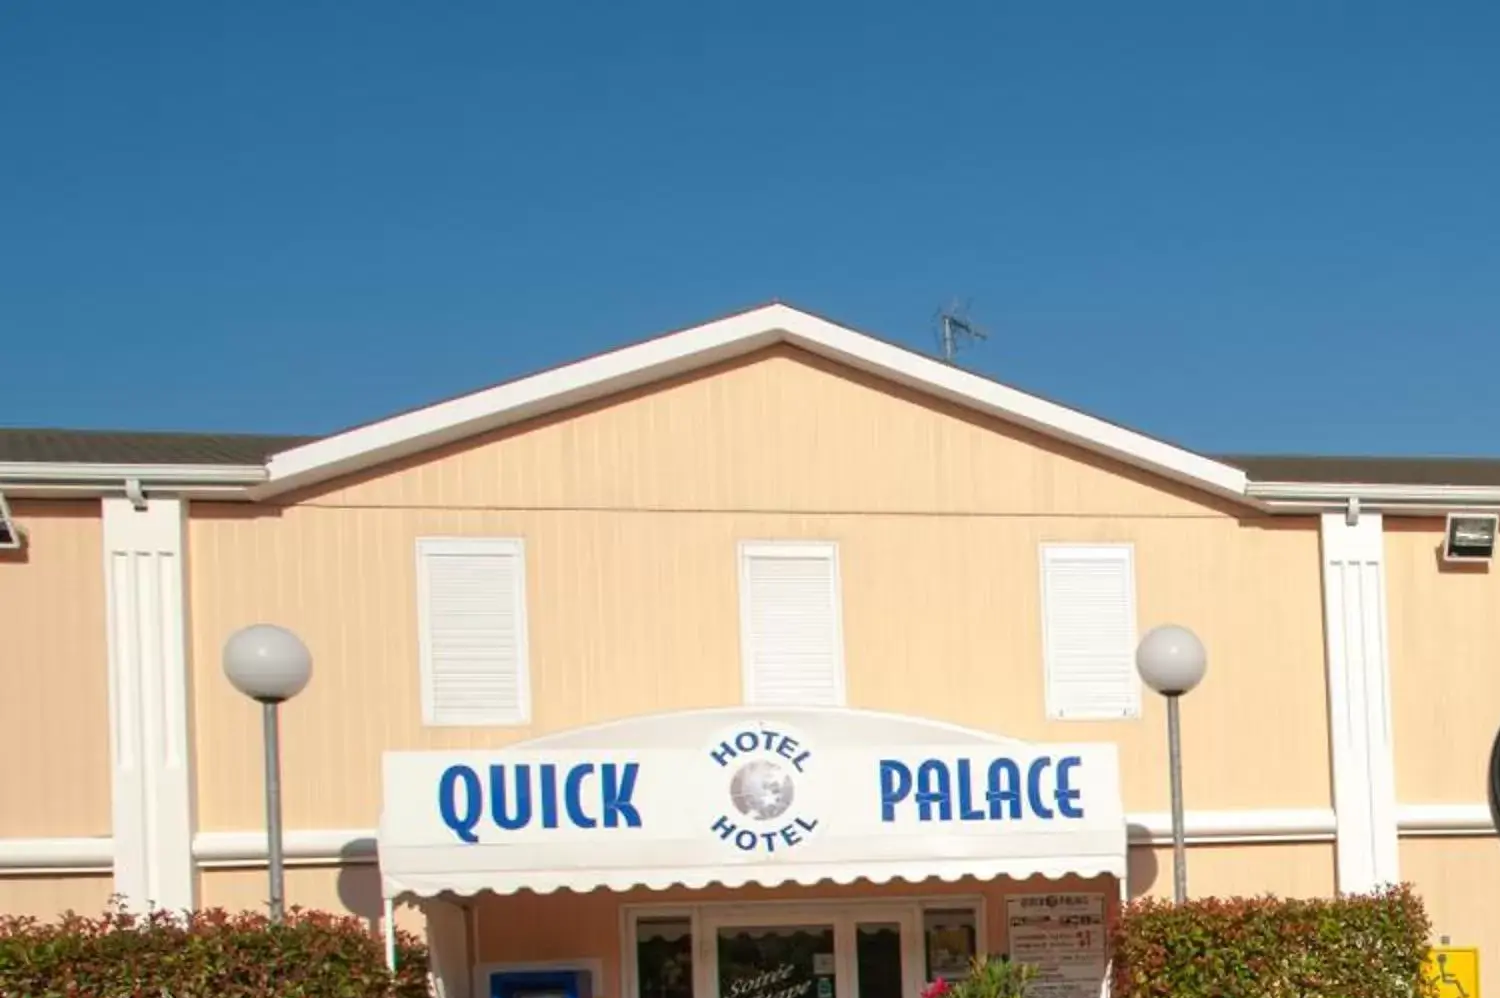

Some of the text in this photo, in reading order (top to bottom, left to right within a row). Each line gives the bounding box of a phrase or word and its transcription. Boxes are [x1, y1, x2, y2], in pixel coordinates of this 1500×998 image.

[710, 730, 810, 773] HOTEL
[439, 763, 642, 843] QUICK
[880, 757, 1084, 822] PALACE
[711, 815, 819, 852] HOTEL
